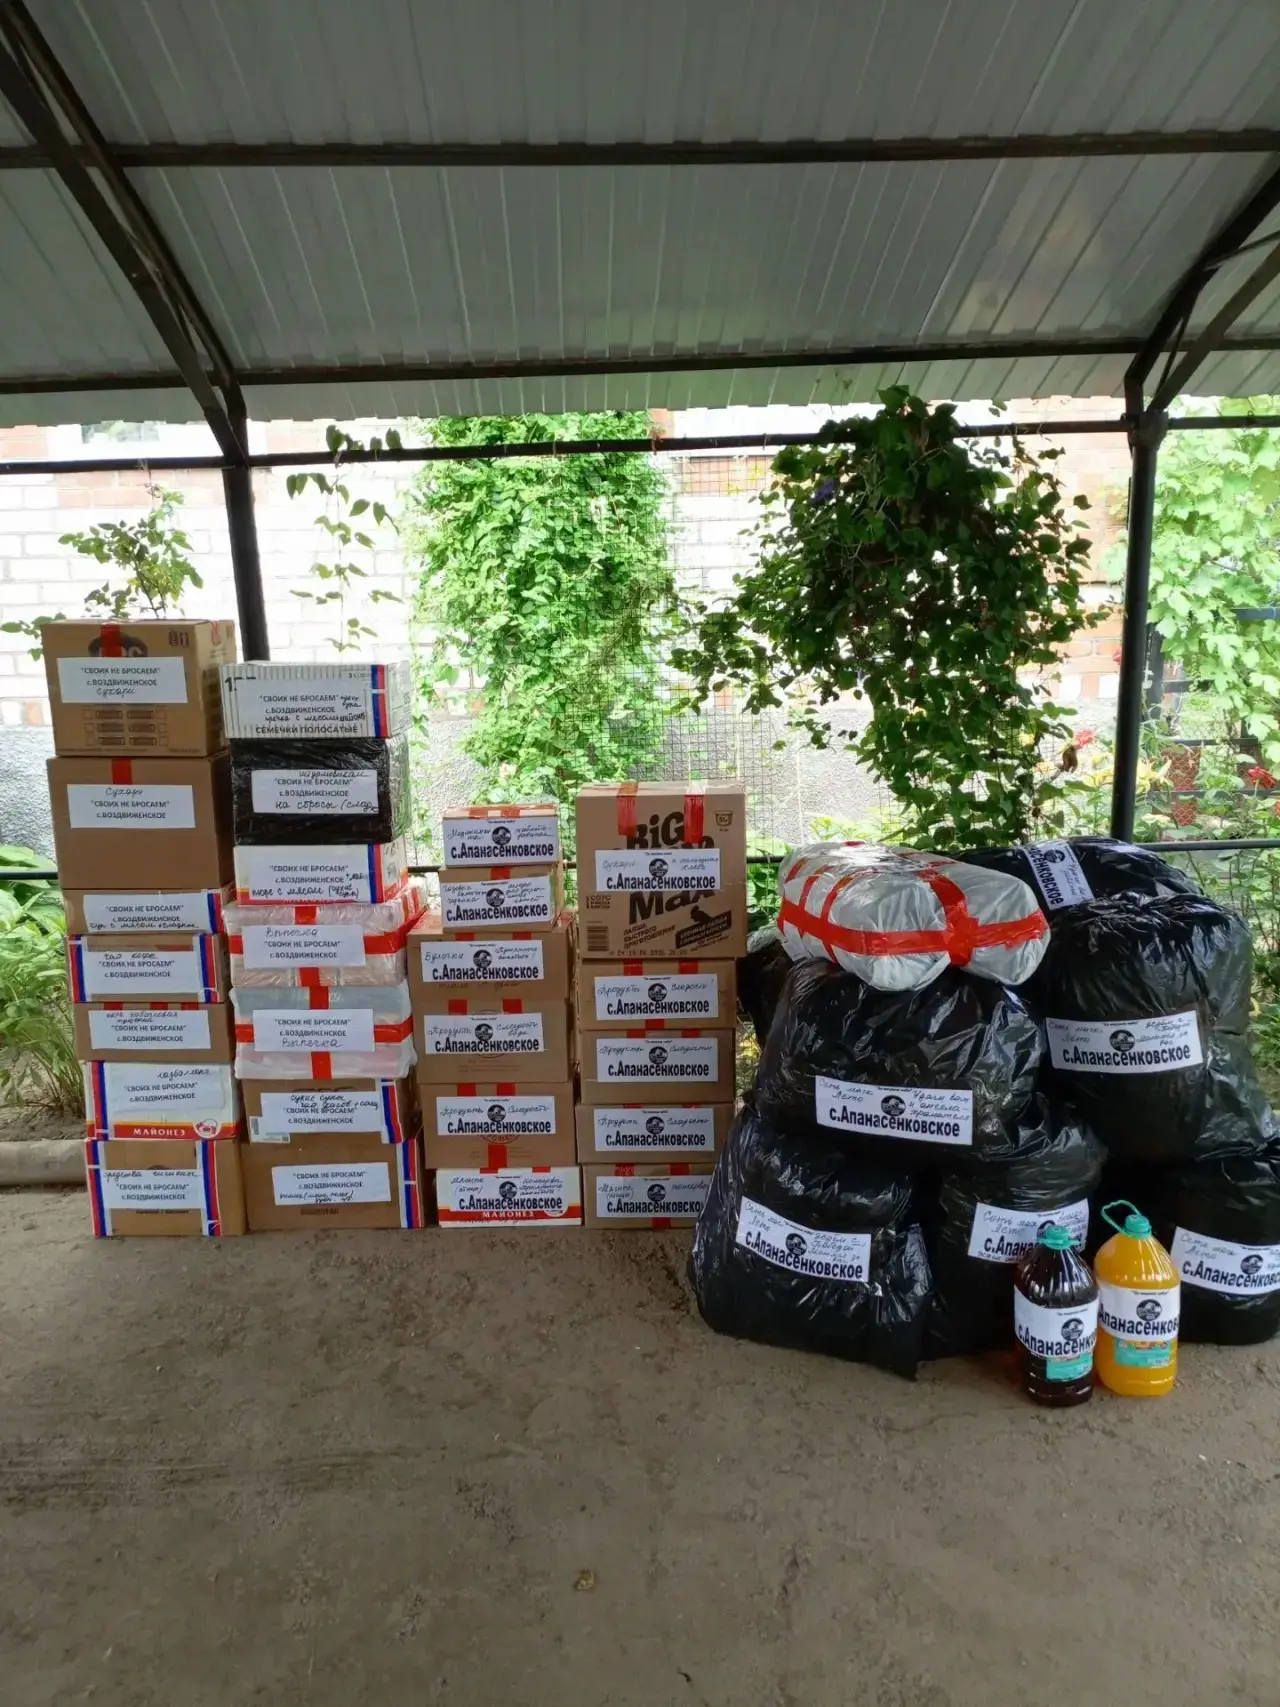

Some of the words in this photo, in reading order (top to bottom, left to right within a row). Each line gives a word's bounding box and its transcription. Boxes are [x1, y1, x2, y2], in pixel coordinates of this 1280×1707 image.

[81, 667, 109, 675] "СВОИХ
[111, 667, 120, 675] НЕ
[121, 666, 160, 675] БРОСАЕМ"
[87, 679, 158, 687] с.ВОЗДВИЖЕНСКОЕ
[300, 694, 339, 702] БРОСАЕМ"
[265, 706, 336, 714] с.ВОЗДВИЖЕНСКОЕ
[256, 726, 298, 734] СЕМЕЧКИ
[300, 725, 358, 734] ПОЛОСАТЫЕ
[314, 778, 354, 786] БРОСАЕМ"
[279, 790, 349, 798] с.ВОЗДВИЖЕНСКОЕ
[96, 812, 167, 820] с.ВОЗДВИЖЕНСКОЕ
[310, 864, 348, 872] БРОСАЕМ"
[275, 876, 344, 884] с.ВОЗДВИЖЕНСКОЕ
[146, 904, 184, 912] БРОСАЕМ"
[302, 940, 340, 948] БРОСАЕМ"
[99, 960, 126, 968] "СВОИХ
[137, 960, 174, 968] БРОСАЕМ"
[313, 1018, 350, 1026] БРОСАЕМ"
[150, 1024, 186, 1032] БРОСАЕМ"
[279, 1030, 346, 1038] с.ВОЗДВИЖЕНСКОЕ
[162, 1082, 199, 1090] БРОСАЕМ"
[129, 1092, 196, 1102] с.ВОЗДВИЖЕНСКОЕ
[133, 1128, 186, 1136] МАЙОНЕЗ
